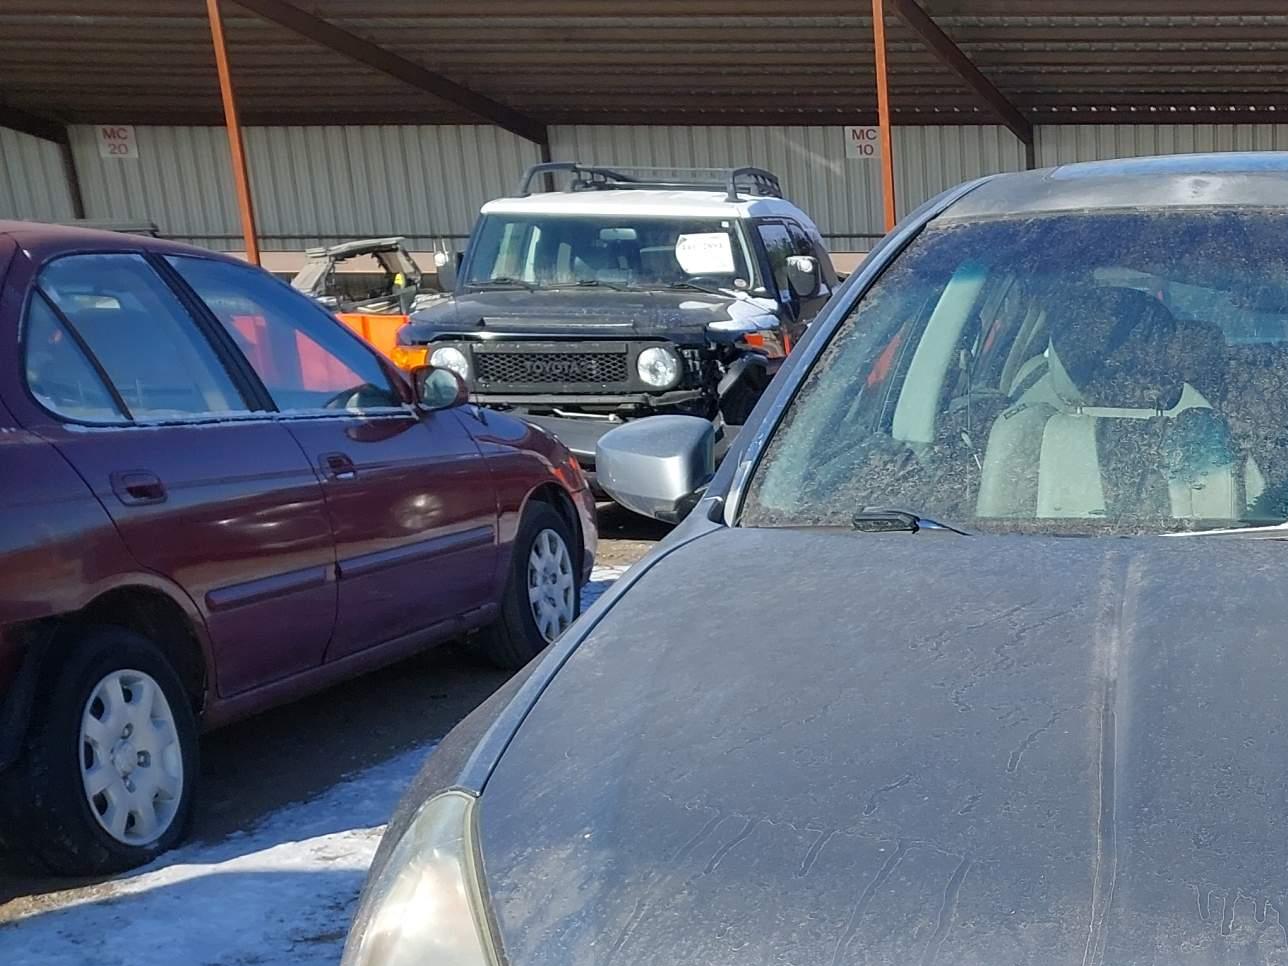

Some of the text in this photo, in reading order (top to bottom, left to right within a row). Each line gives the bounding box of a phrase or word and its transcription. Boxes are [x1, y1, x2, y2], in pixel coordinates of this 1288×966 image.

[102, 127, 128, 139] MC
[852, 128, 877, 140] MC
[857, 144, 874, 155] 10
[524, 360, 582, 374] TOYOTA
